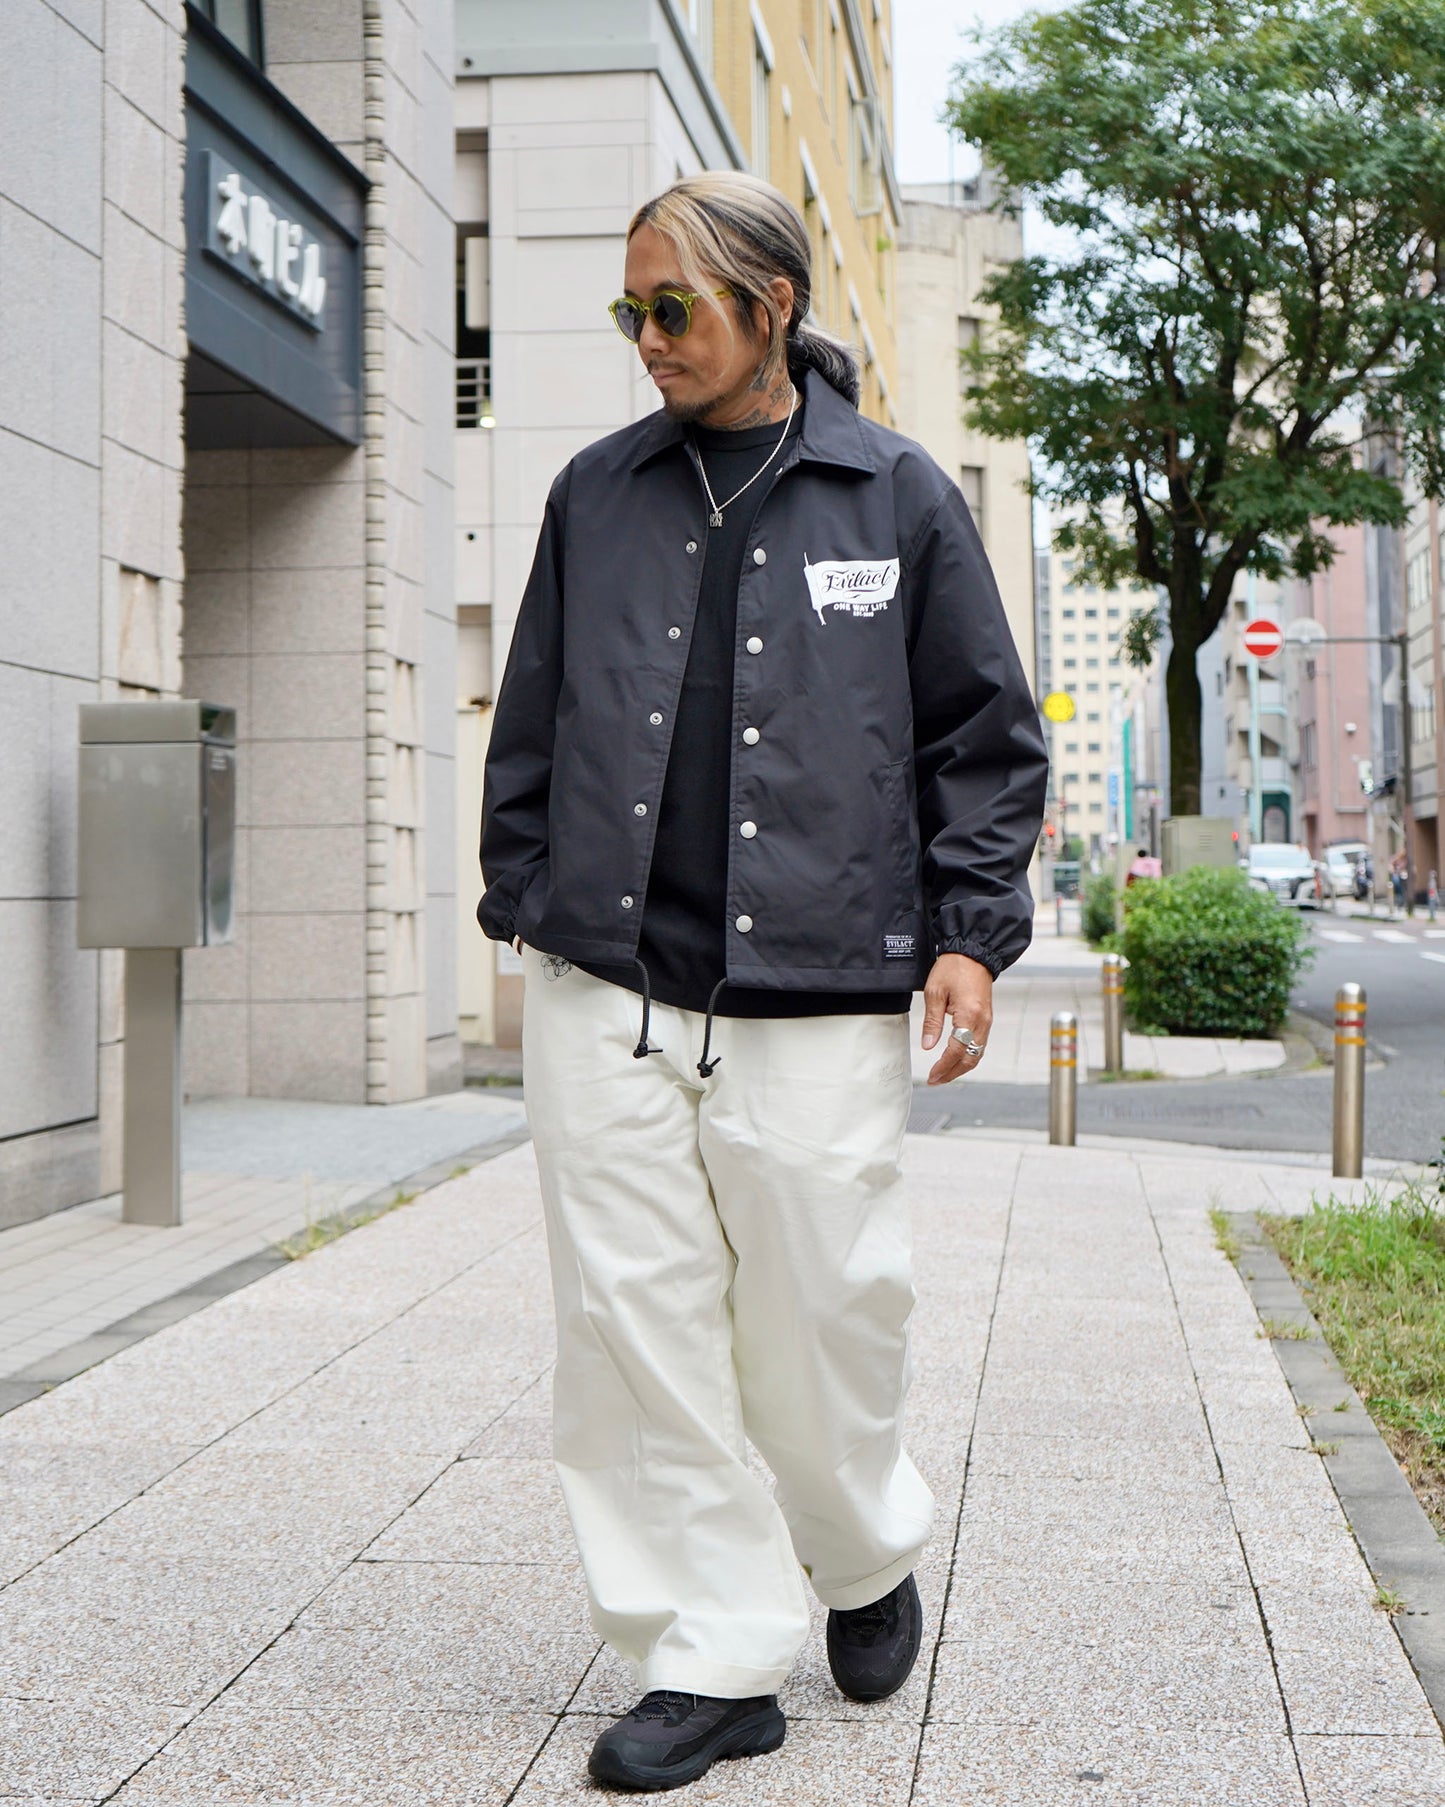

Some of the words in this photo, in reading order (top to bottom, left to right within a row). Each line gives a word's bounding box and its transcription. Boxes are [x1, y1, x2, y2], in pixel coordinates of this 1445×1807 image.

[216, 173, 326, 315] 本町ビル
[822, 565, 892, 594] Evilact
[833, 603, 851, 611] ONE
[852, 604, 870, 612] WAY
[871, 602, 888, 611] LIFE
[886, 940, 913, 948] EVILACT
